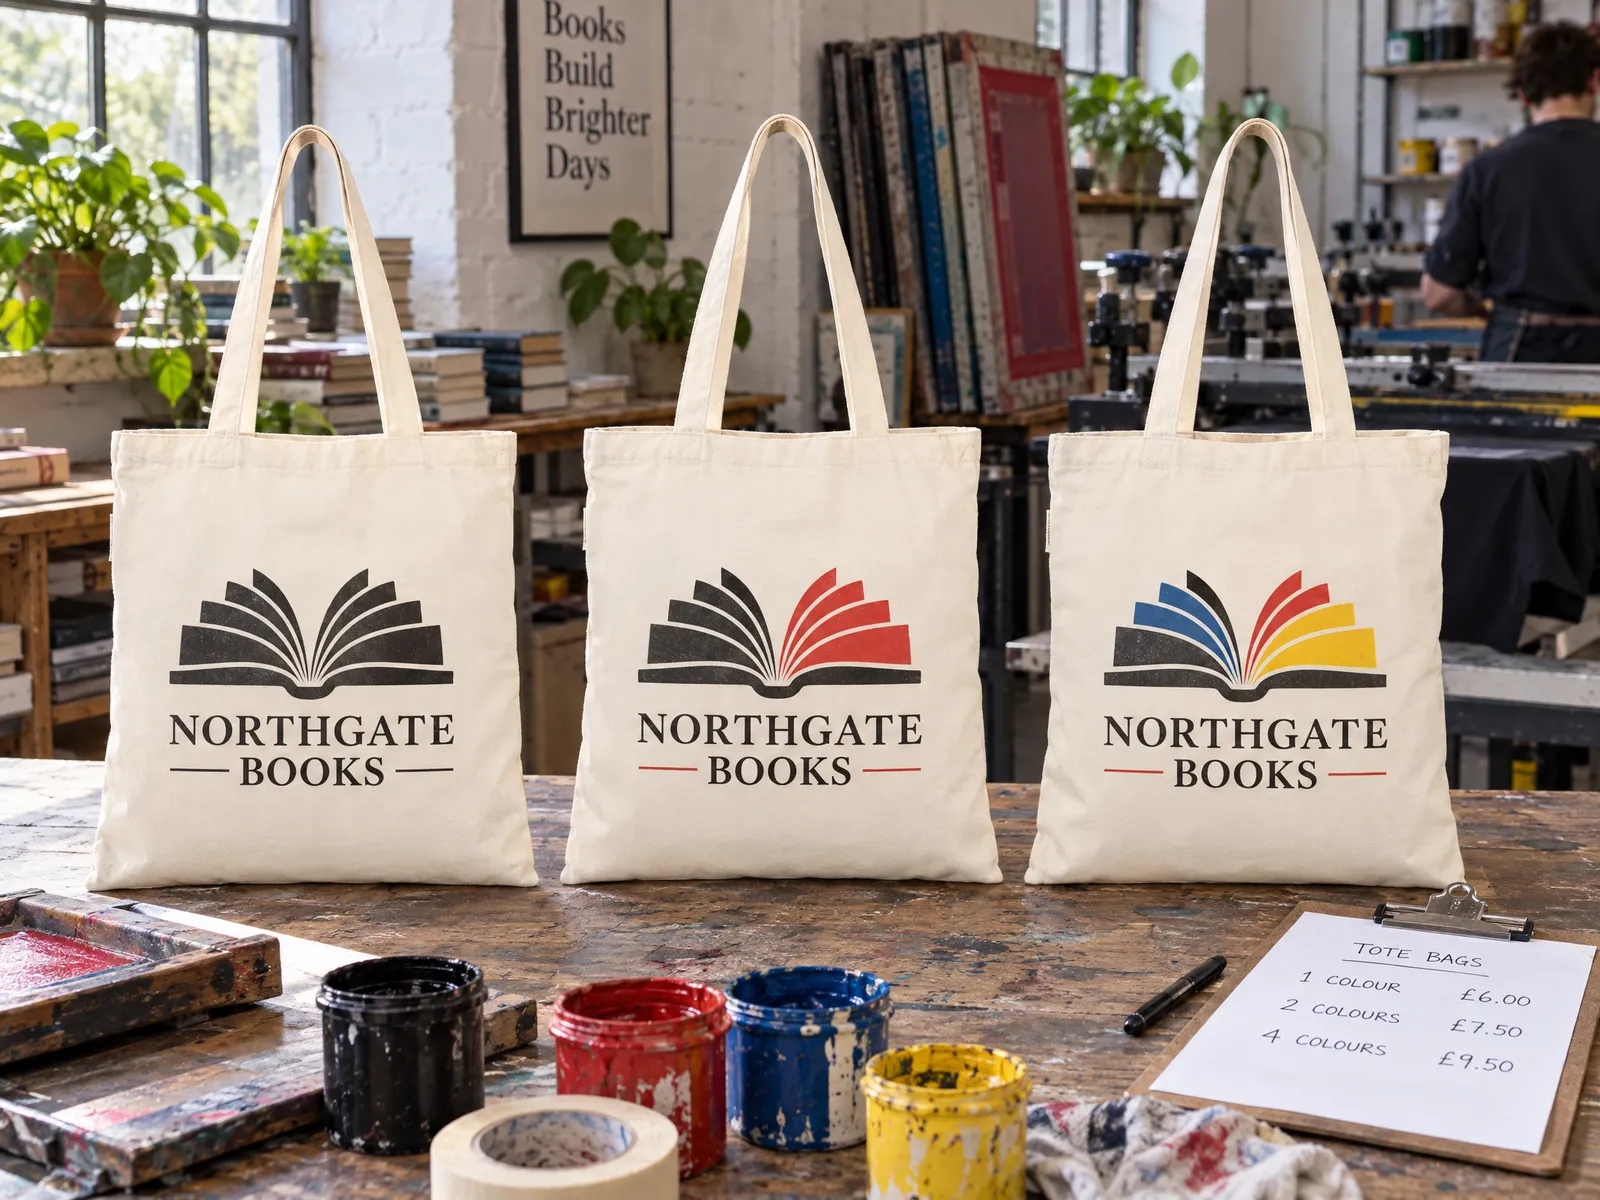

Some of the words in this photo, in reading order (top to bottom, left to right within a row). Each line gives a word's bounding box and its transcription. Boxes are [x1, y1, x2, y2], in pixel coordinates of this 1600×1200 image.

[544, 0, 626, 44] Books
[545, 48, 614, 89] Build
[545, 96, 651, 145] Brighter
[546, 143, 611, 191] Days
[169, 714, 455, 747] NORTHGATE
[637, 713, 923, 747] NORTHGATE
[1103, 715, 1388, 750] NORTHGATE
[239, 756, 385, 787] BOOKS
[707, 755, 852, 786] BOOKS
[1174, 758, 1318, 790] BOOKS
[1353, 942, 1412, 959] TOTE
[1426, 951, 1482, 968] BAGS
[1299, 971, 1312, 983] 1
[1326, 975, 1401, 993] COLOUR
[1460, 988, 1531, 1007] £6.00
[1280, 998, 1299, 1012] 2
[1312, 1003, 1400, 1024] COLOURS
[1450, 1018, 1523, 1038] £7.50
[1262, 1028, 1281, 1044] 4
[1295, 1034, 1386, 1056] COLOURS
[1438, 1051, 1514, 1073] £9.50
